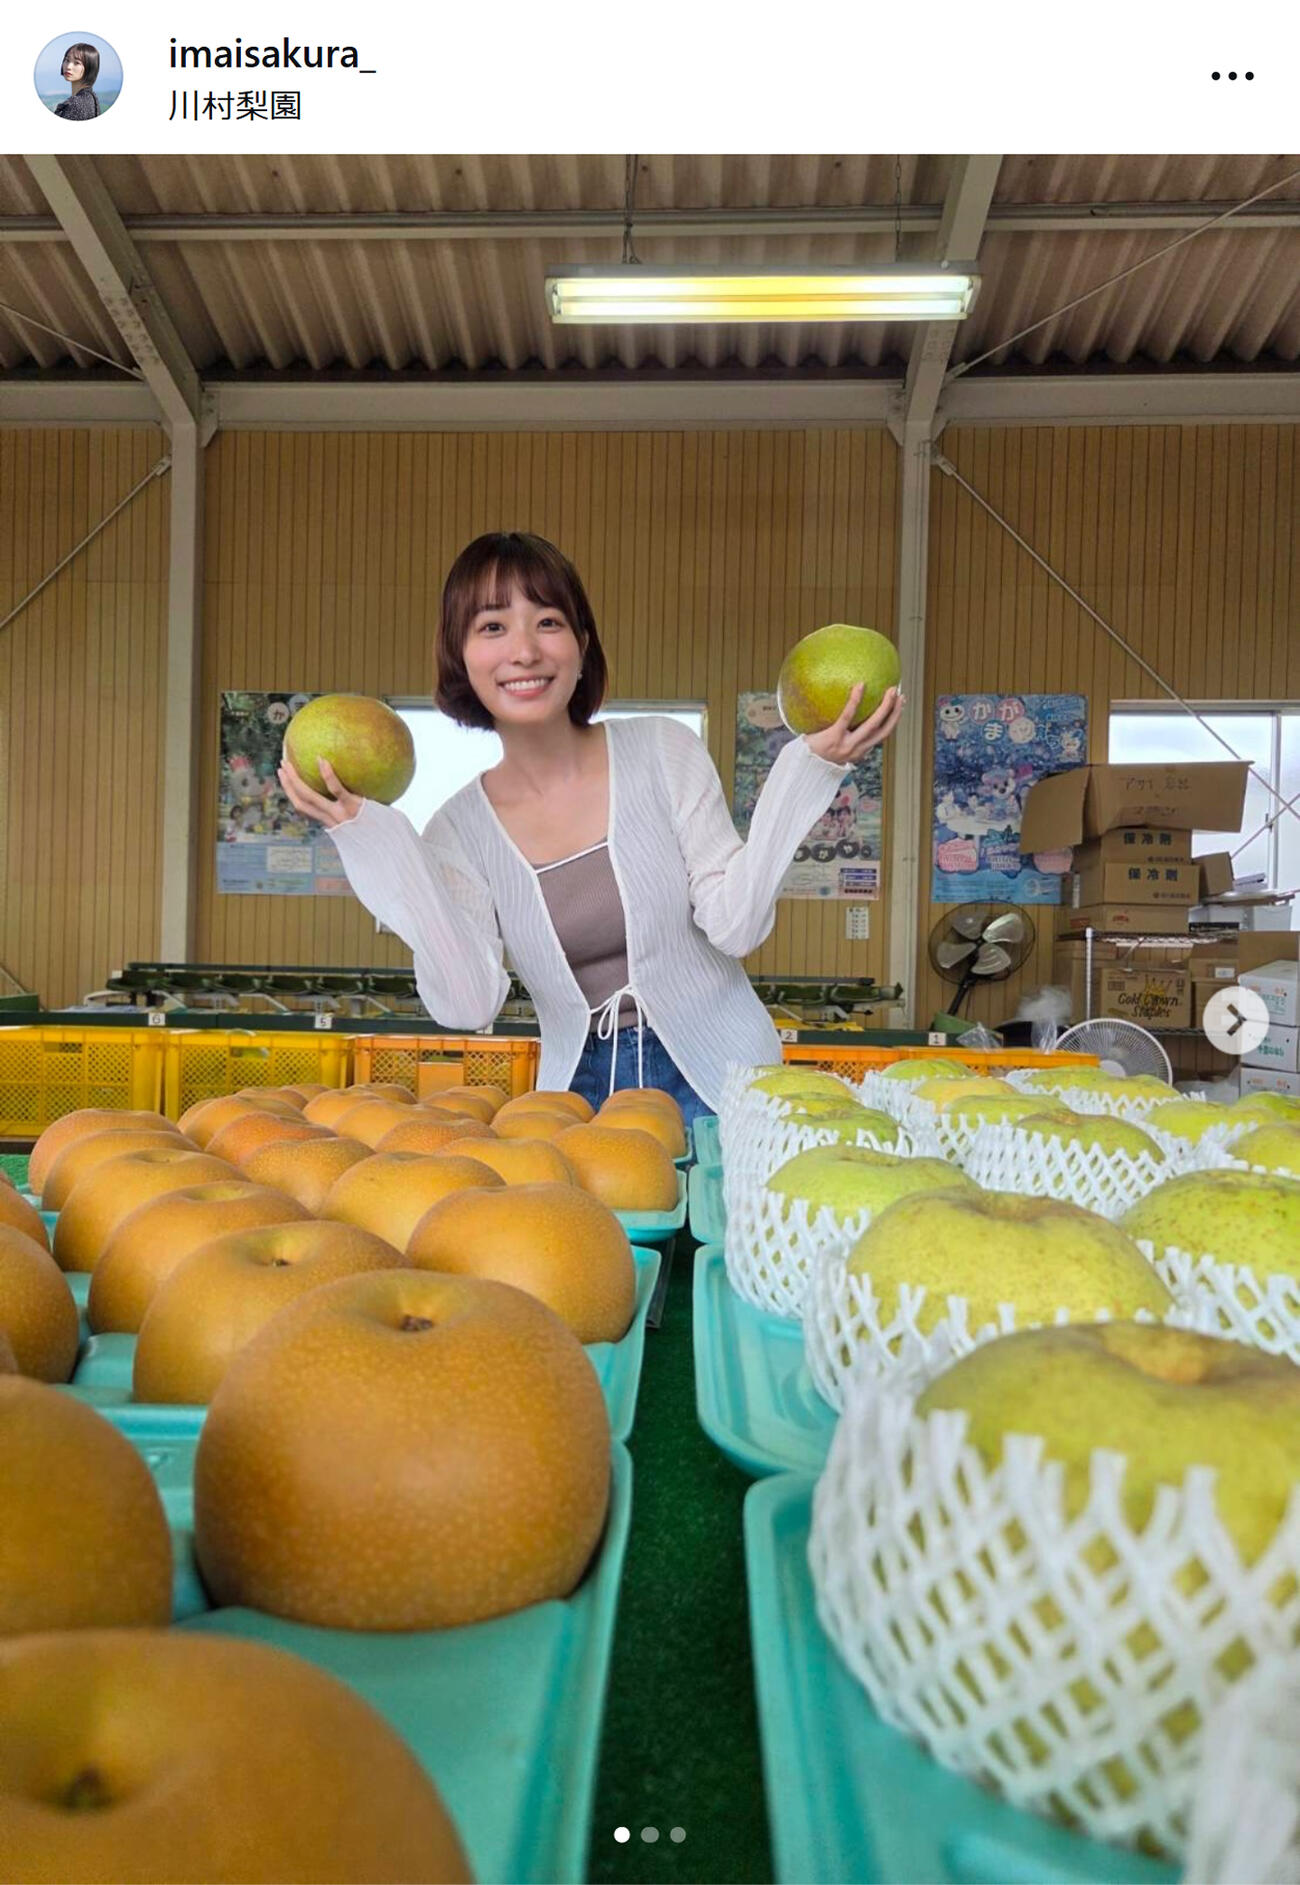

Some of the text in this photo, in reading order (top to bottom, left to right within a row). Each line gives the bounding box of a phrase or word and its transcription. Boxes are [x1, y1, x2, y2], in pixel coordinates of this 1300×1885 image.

[1124, 832, 1171, 845] 保冷剤
[1129, 867, 1177, 881] 保冷剤
[1118, 992, 1142, 1005] Gold
[152, 1013, 161, 1024] 6
[319, 1017, 327, 1027] 5
[785, 1031, 793, 1041] 2
[932, 1034, 939, 1044] 1
